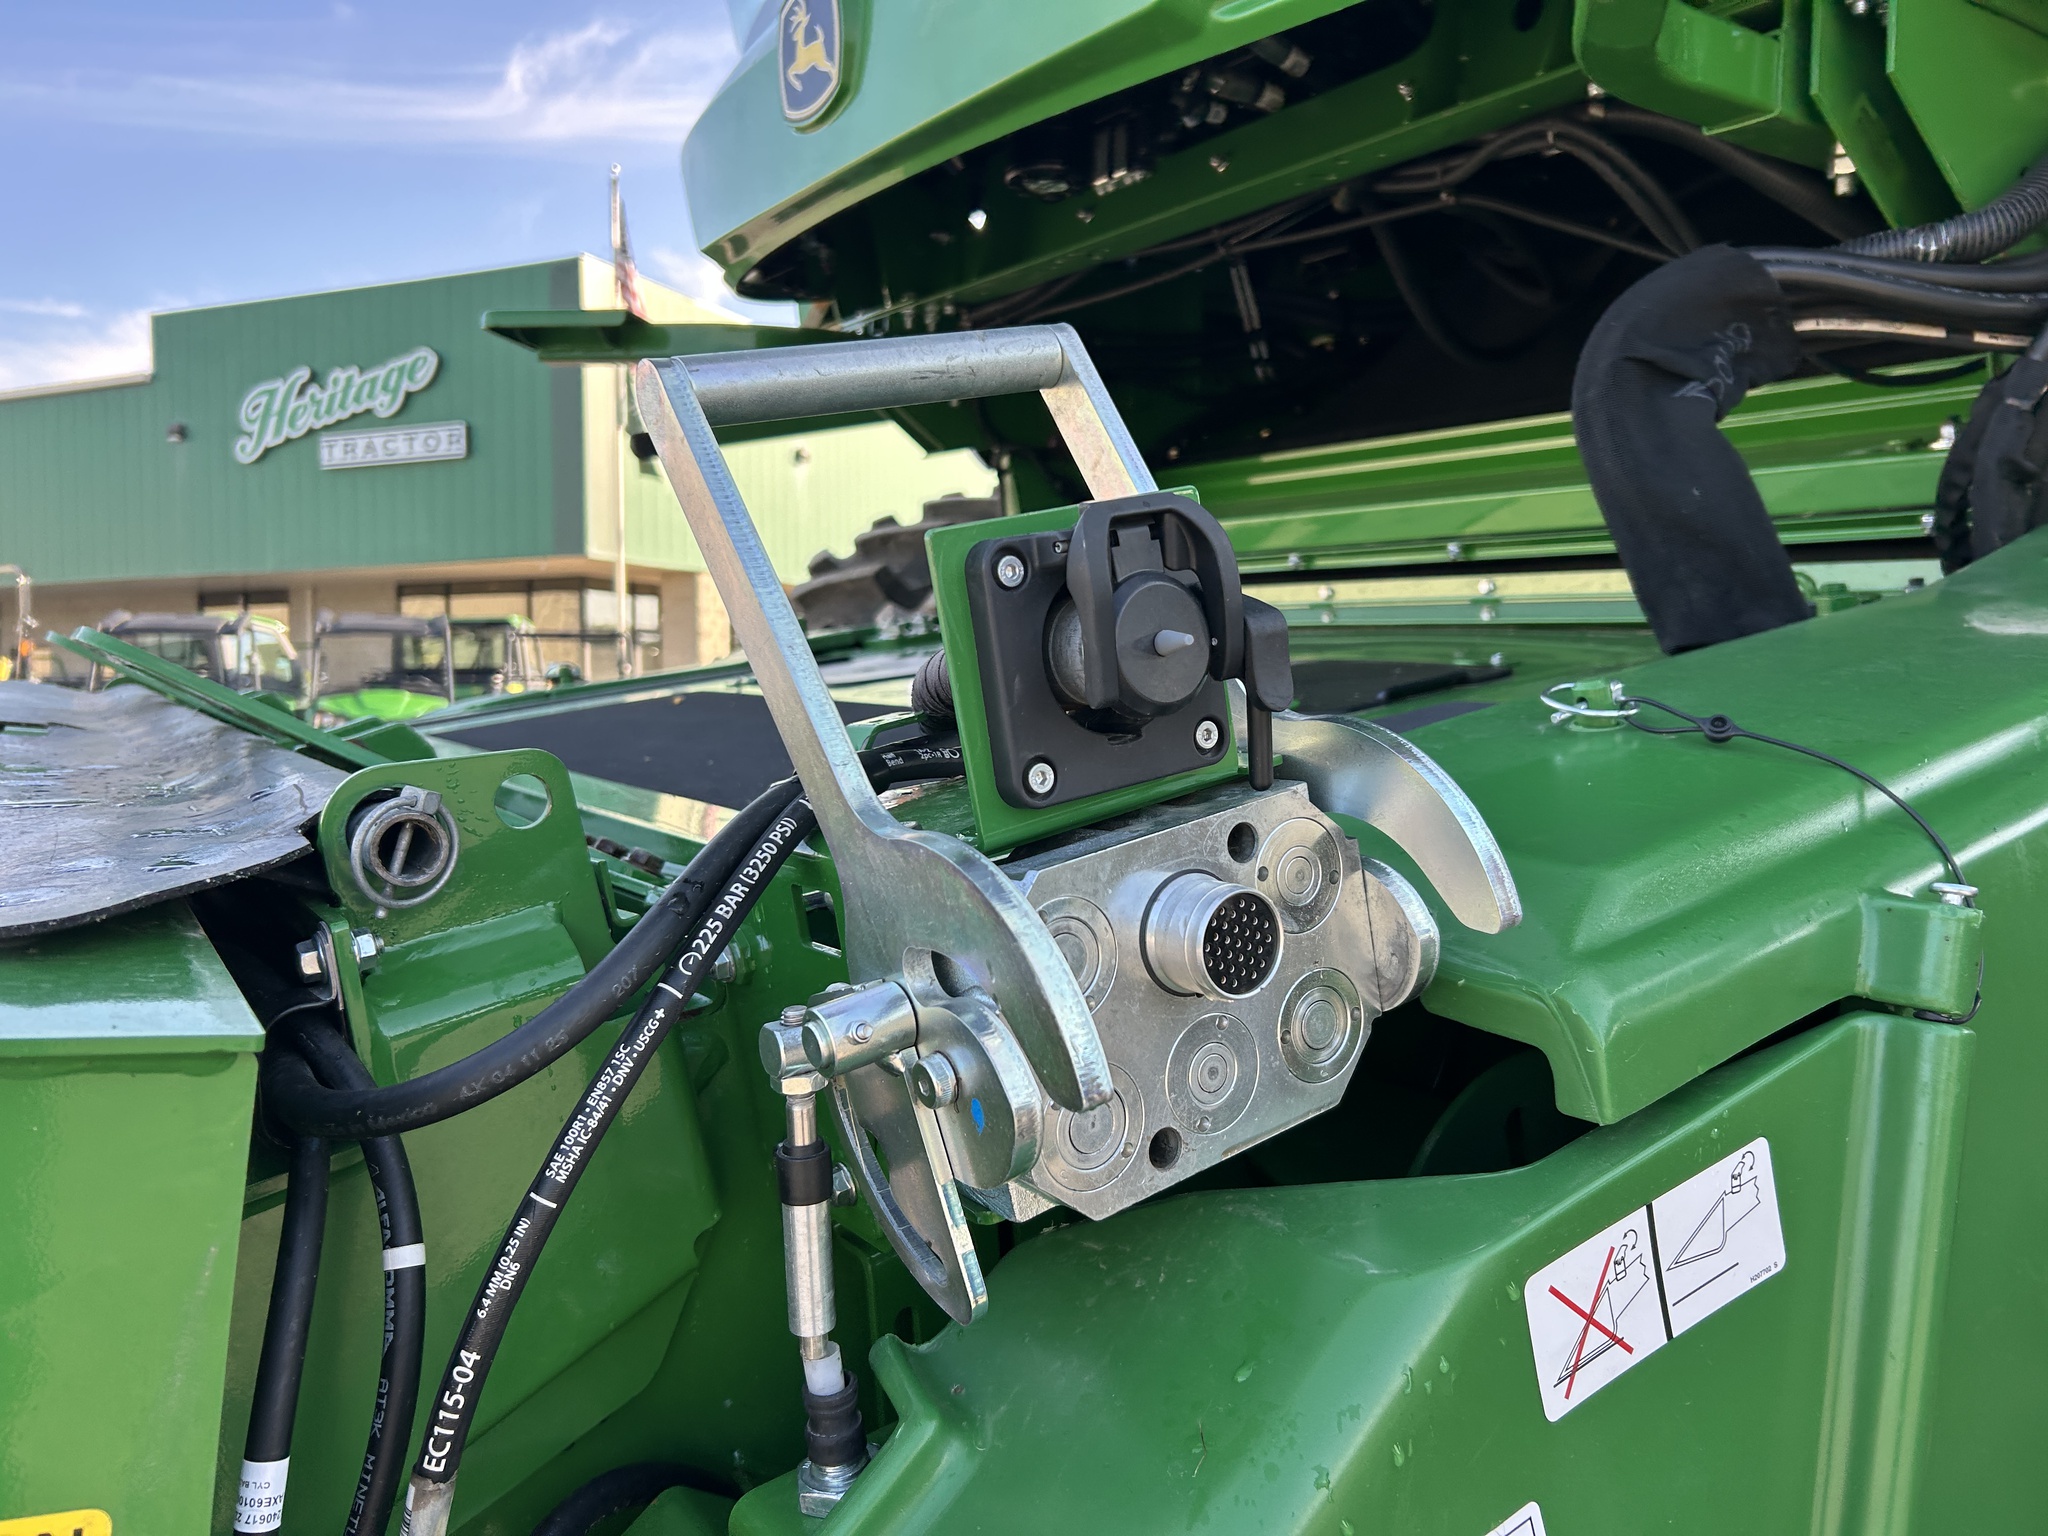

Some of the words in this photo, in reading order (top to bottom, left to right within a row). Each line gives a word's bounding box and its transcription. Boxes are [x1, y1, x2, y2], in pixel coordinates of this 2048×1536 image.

[234, 346, 438, 464] Heritage
[321, 428, 463, 463] TRACTOR
[692, 918, 724, 954] 225
[715, 882, 749, 919] BAR
[739, 842, 778, 884] (3250
[769, 817, 798, 845] PSI)
[546, 1152, 566, 1179] SAE
[560, 1115, 588, 1151] 100R1
[586, 1067, 615, 1107] EN857
[611, 1043, 631, 1065] 1SC
[555, 1145, 584, 1183] MSHA
[577, 1095, 613, 1144] IC-84/41
[612, 1058, 635, 1087] DNV
[477, 1298, 491, 1319] 6.4
[489, 1270, 505, 1298] MM
[499, 1237, 520, 1270] (0.25
[511, 1217, 531, 1239] IN)
[499, 1261, 521, 1291] DN6
[371, 1378, 390, 1438] AT3K
[422, 1349, 481, 1473] EC115-04
[252, 1481, 271, 1490] CYL
